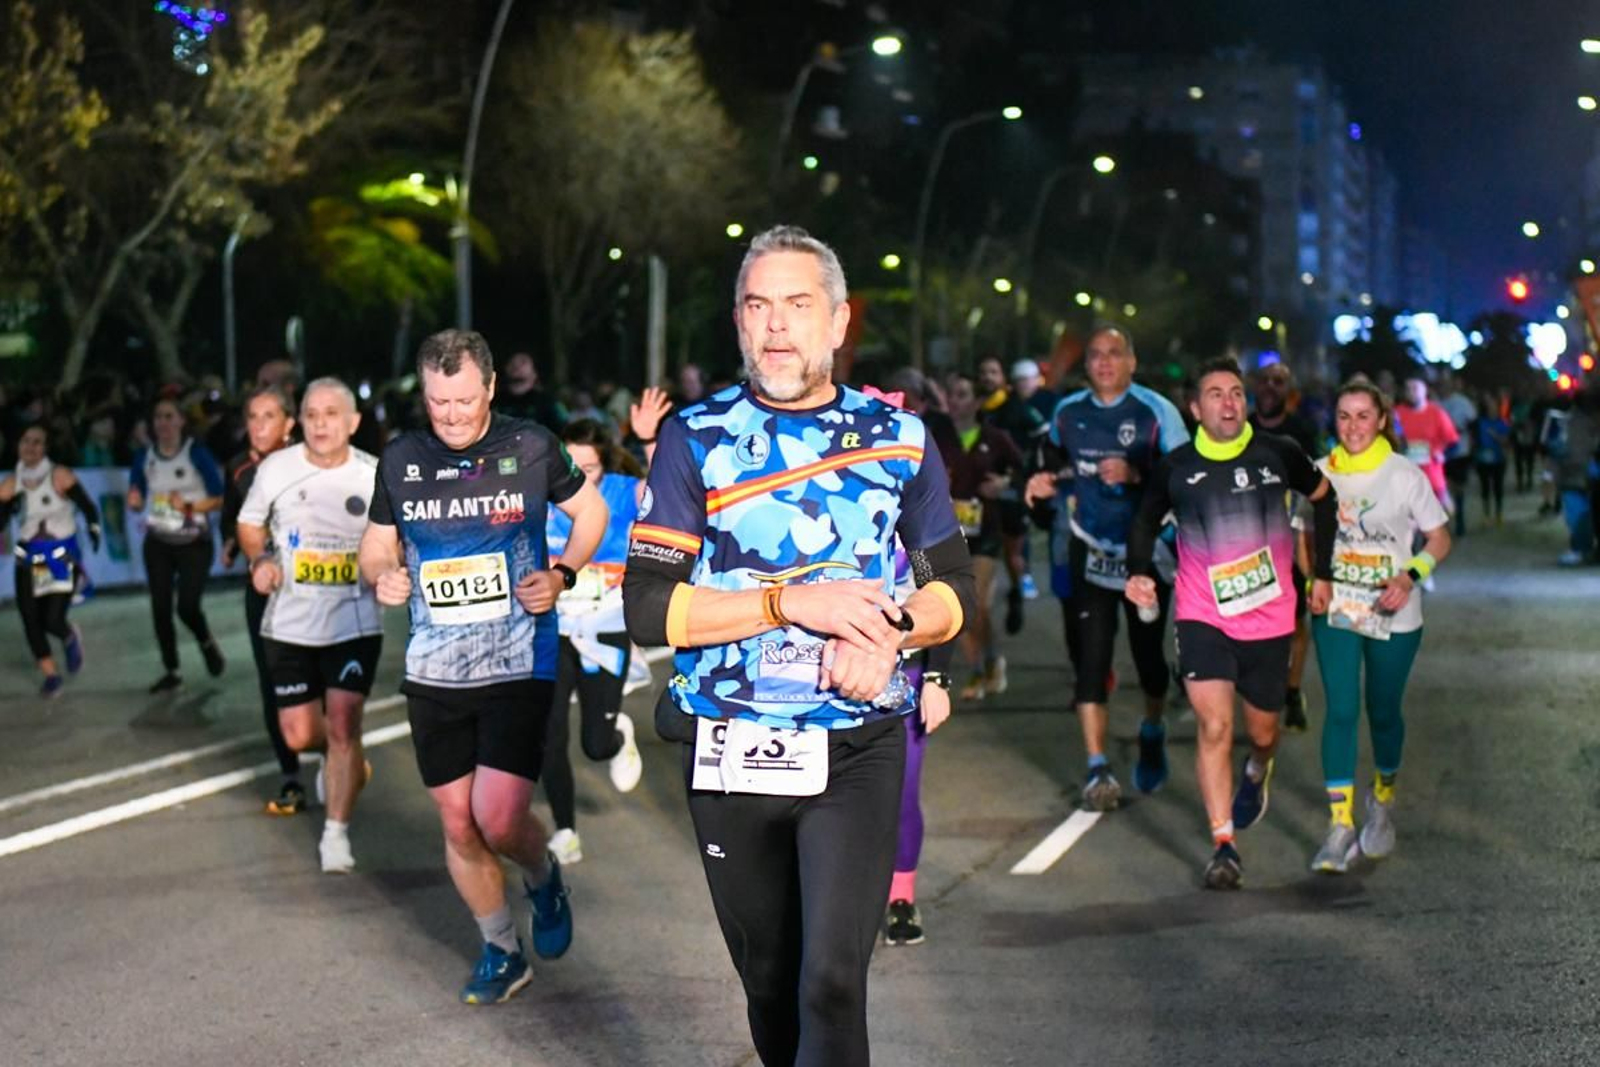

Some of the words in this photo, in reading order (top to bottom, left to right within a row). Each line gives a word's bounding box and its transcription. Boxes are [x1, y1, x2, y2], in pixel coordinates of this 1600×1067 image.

[402, 500, 441, 521] SAN
[447, 489, 524, 518] ANTÓN
[490, 509, 526, 525] 2025
[299, 562, 353, 582] 3910
[1217, 563, 1272, 599] 2939
[1333, 561, 1389, 584] 2923
[426, 573, 503, 600] 10181
